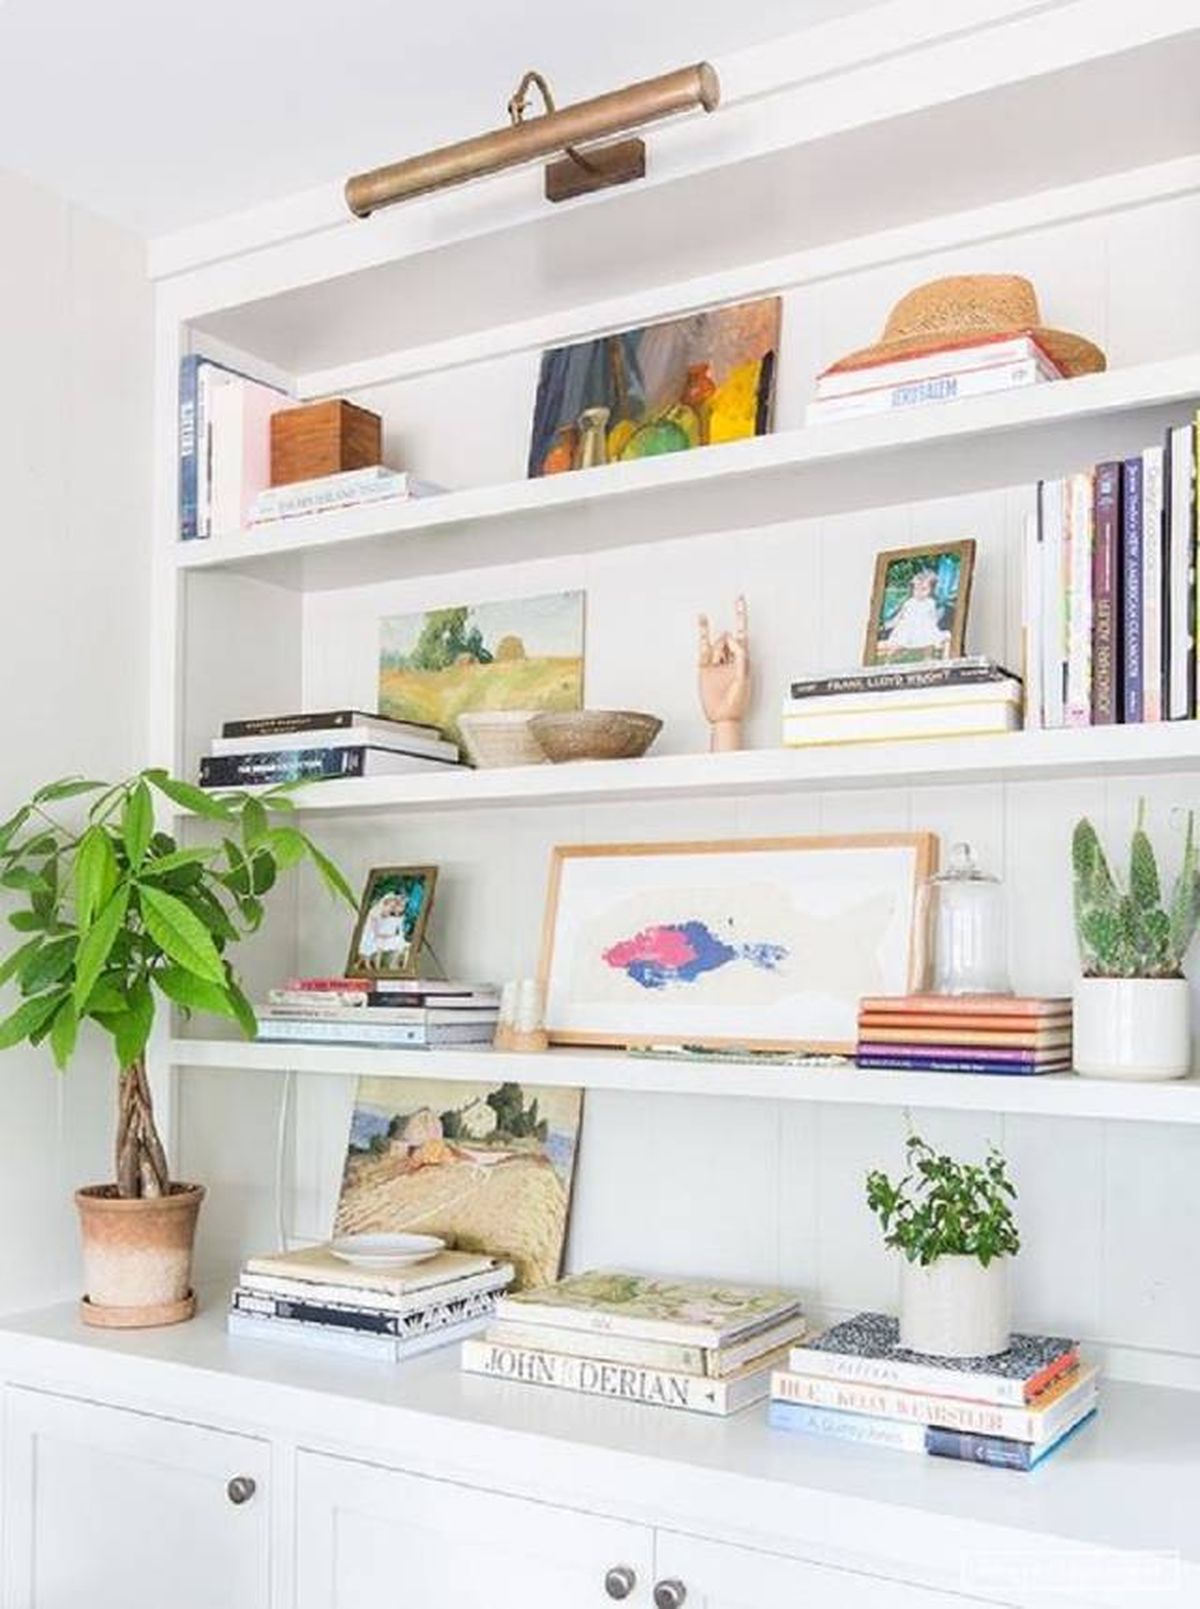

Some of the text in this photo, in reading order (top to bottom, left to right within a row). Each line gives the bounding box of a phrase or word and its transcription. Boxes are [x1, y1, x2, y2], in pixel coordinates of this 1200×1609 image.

[891, 378, 958, 406] JERUSALEM
[1127, 531, 1139, 556] NEW
[1127, 559, 1139, 618] AMERICAN
[1098, 600, 1110, 714] JONATHAN ADLER
[1127, 619, 1139, 678] GLAMOUR
[827, 678, 864, 692] FRANK
[867, 674, 903, 688] LLOYD
[907, 670, 950, 685] WRIGHT
[484, 1348, 691, 1405] JOHN DERIAN
[837, 1389, 887, 1413] KELLY
[896, 1397, 1003, 1429] WEARSTLER
